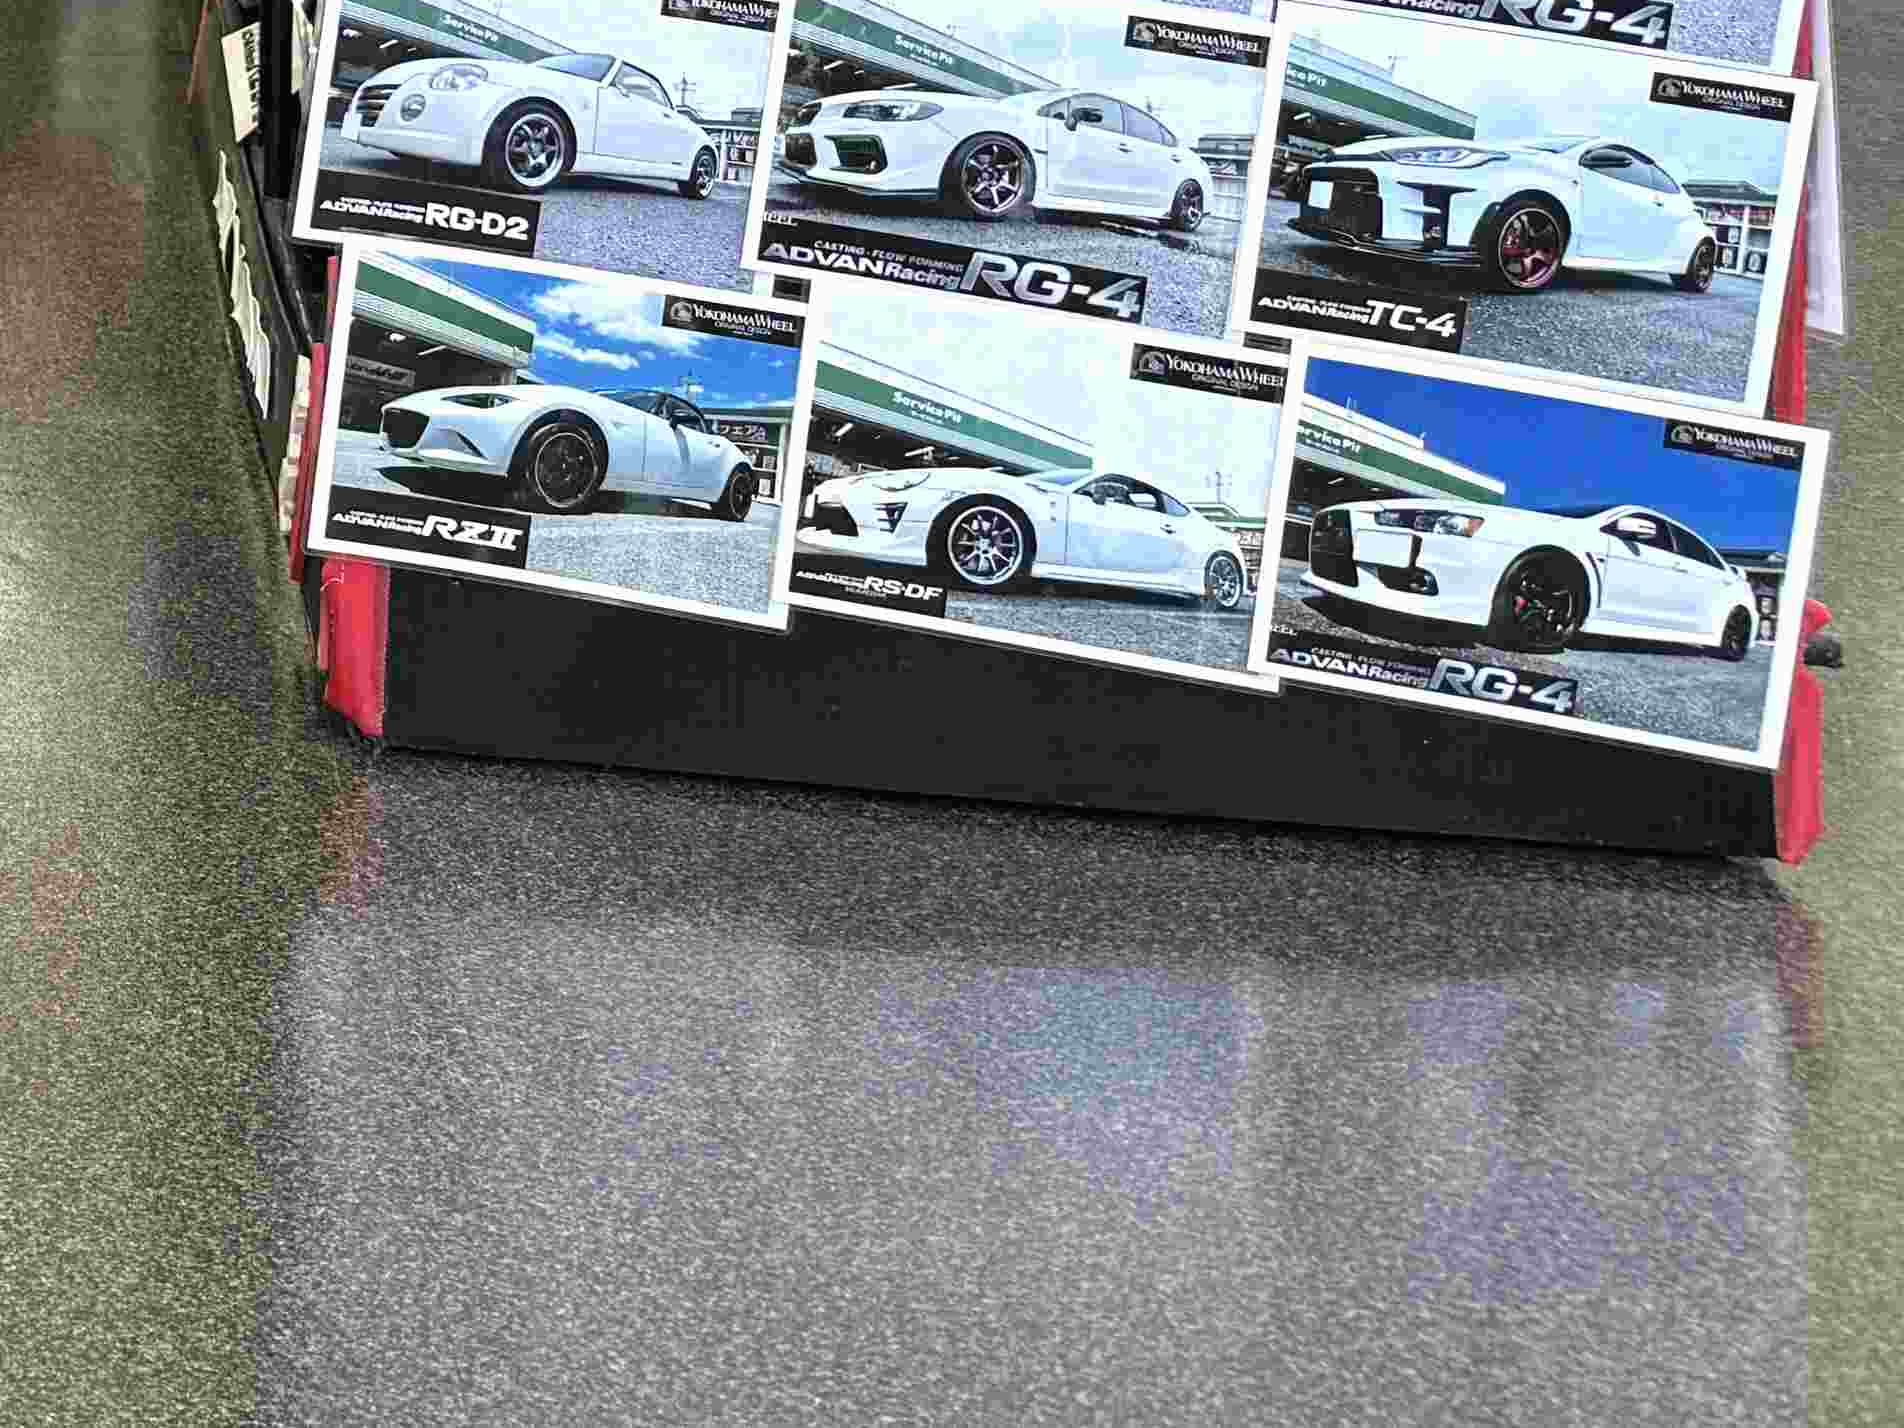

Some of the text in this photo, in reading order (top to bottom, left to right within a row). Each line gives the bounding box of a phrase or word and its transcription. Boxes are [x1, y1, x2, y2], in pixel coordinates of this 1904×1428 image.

[423, 203, 531, 241] RG-D2
[959, 250, 1149, 324] RG-4
[1363, 298, 1459, 336] TC-4
[1427, 658, 1578, 715] RG-4
